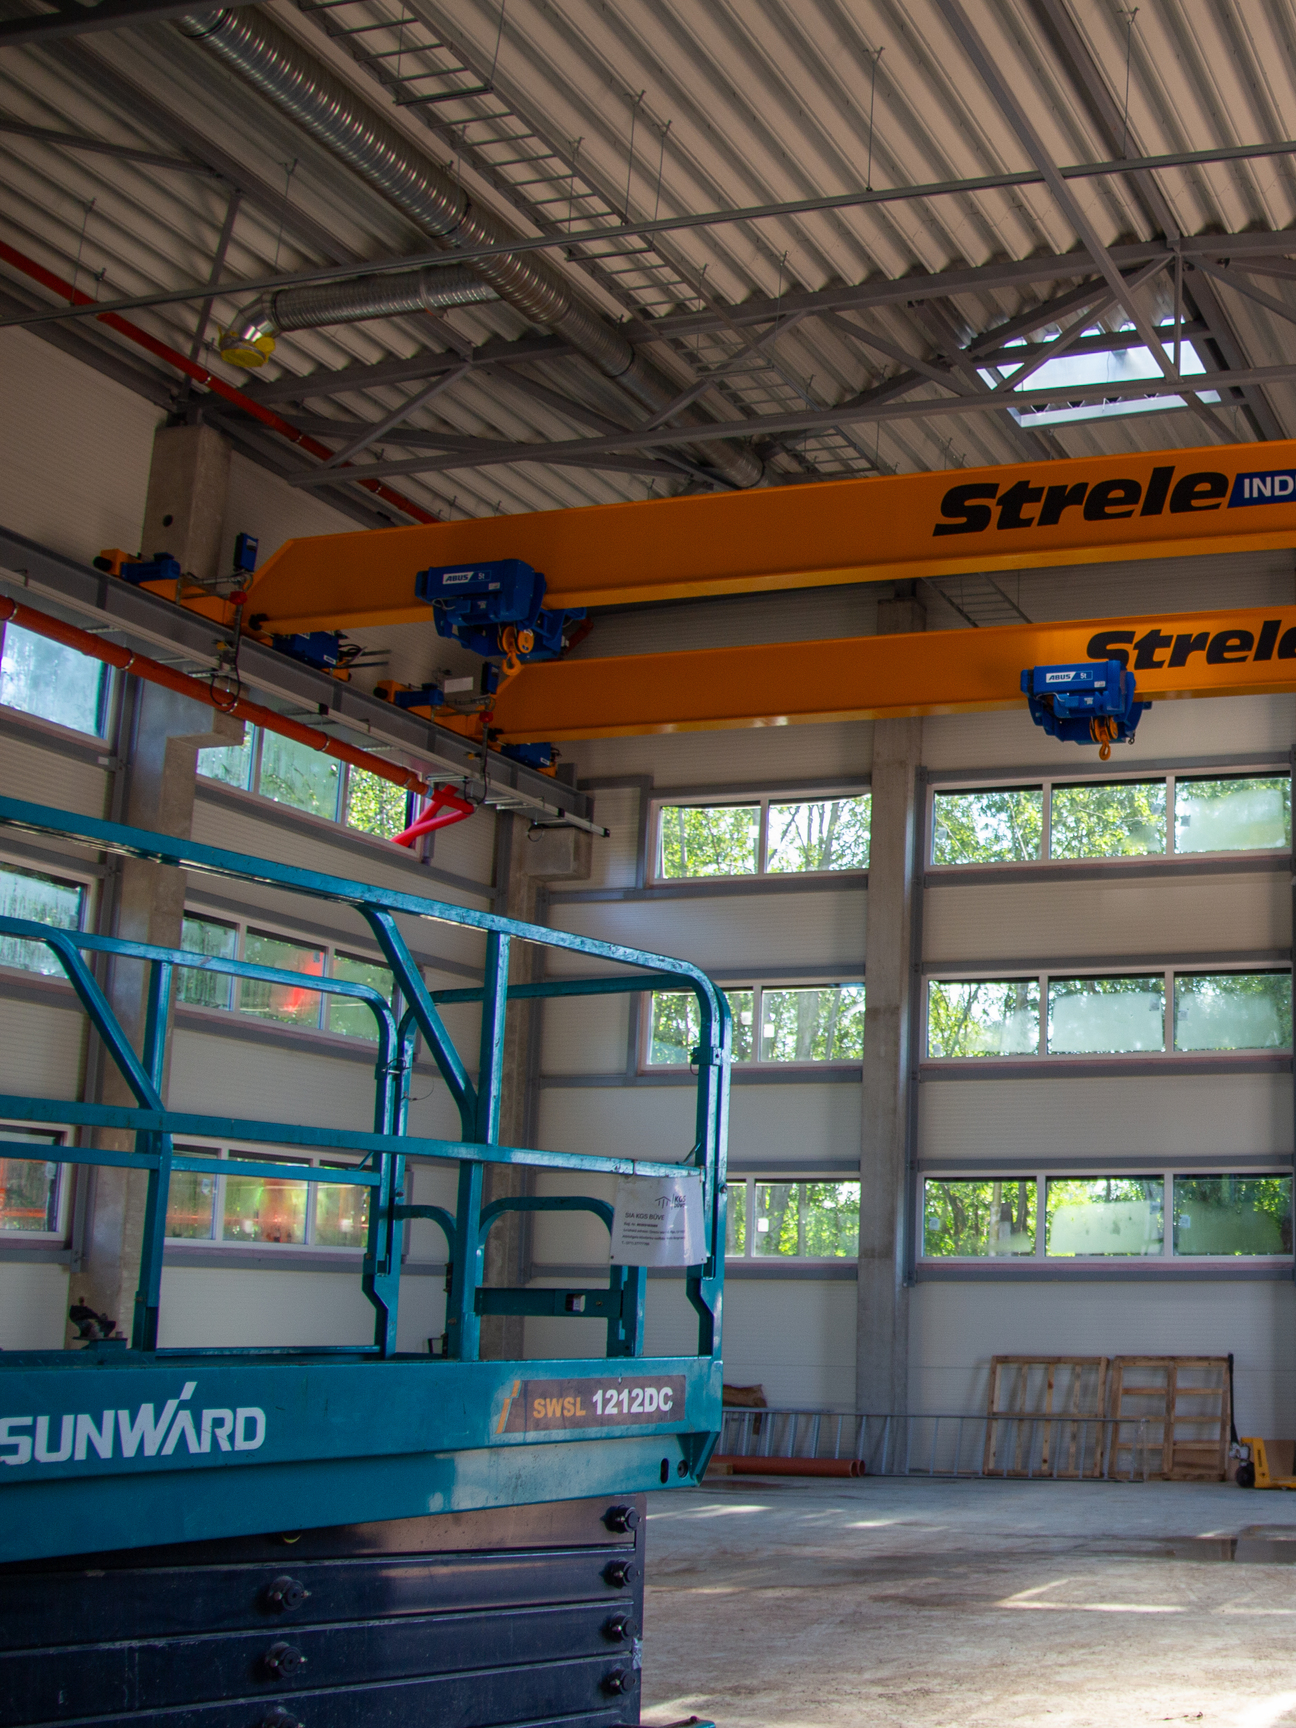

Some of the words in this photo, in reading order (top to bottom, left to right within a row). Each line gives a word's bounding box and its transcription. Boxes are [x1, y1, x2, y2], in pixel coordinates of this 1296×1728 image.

[932, 466, 1229, 537] Strele
[445, 574, 469, 583] ABUS
[1048, 673, 1071, 682] ABUS
[533, 1397, 586, 1418] SWSL
[592, 1386, 673, 1415] 1212DC
[0, 1381, 267, 1466] SUNWARD
